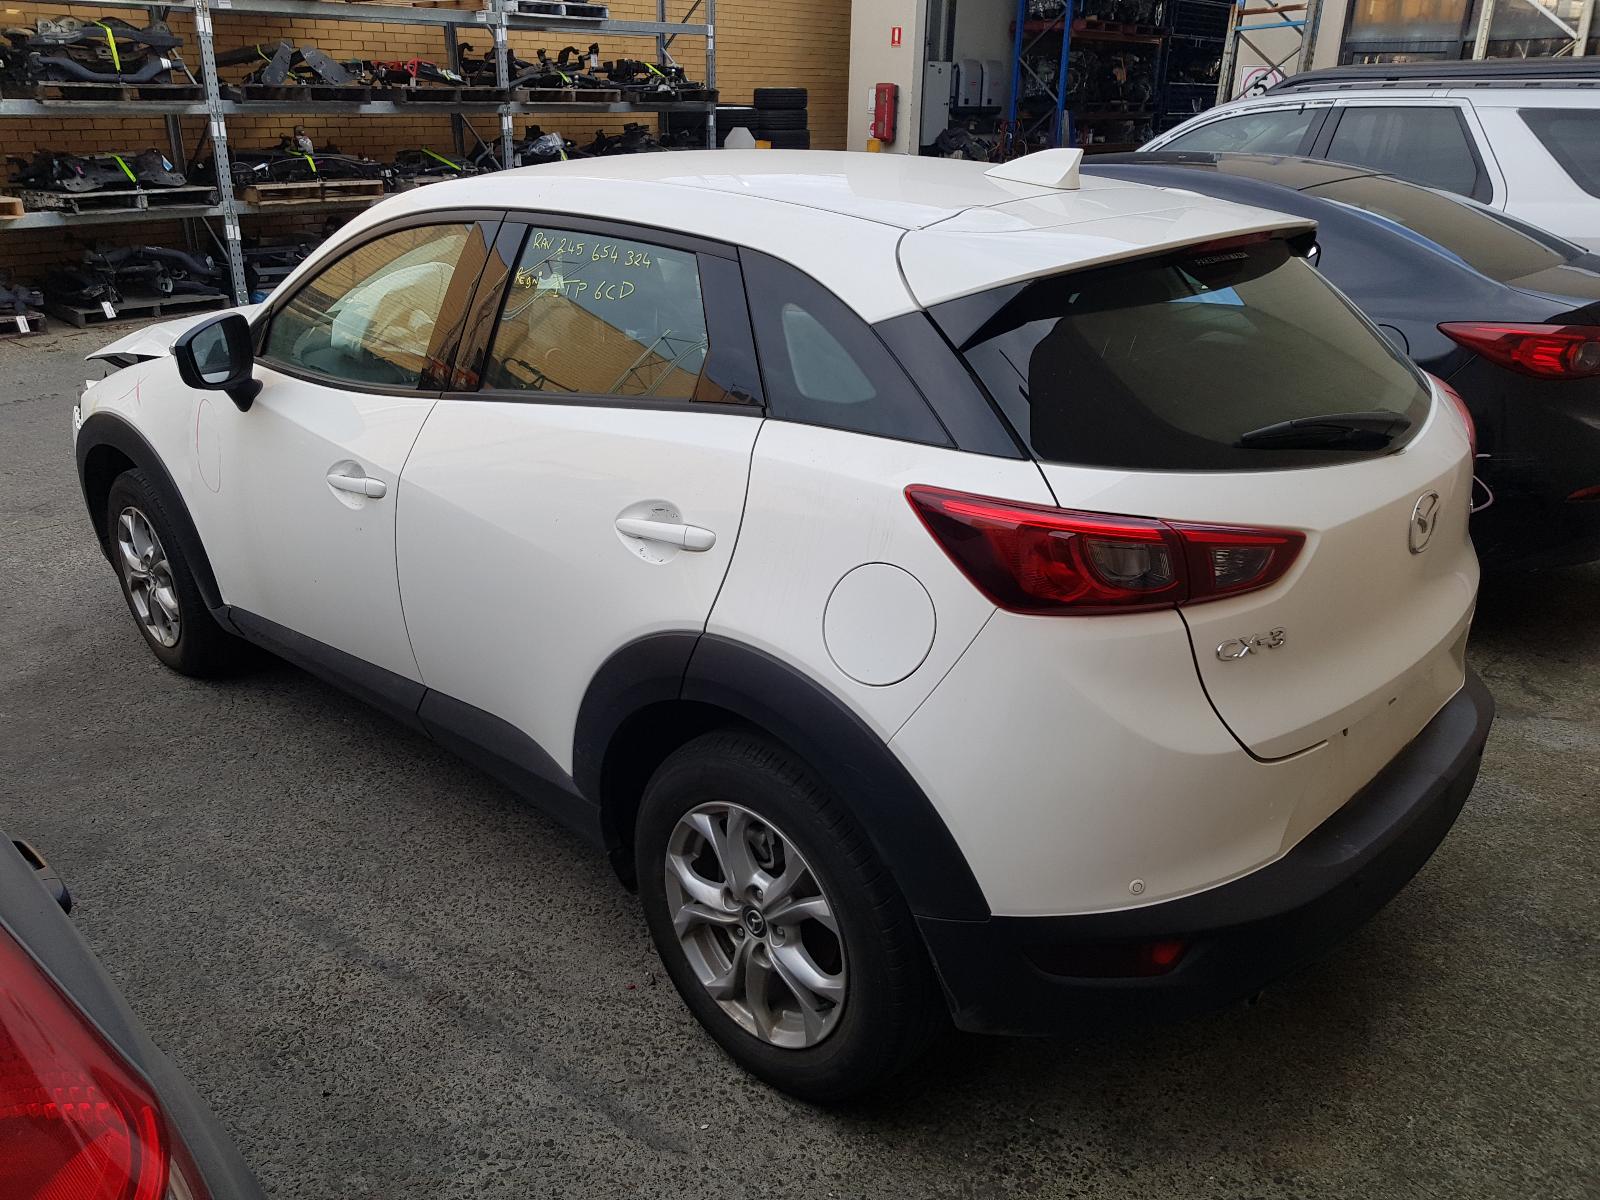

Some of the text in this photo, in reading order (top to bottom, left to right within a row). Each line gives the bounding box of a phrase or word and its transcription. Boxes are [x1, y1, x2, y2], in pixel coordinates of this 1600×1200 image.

[532, 232, 651, 268] RAV 245 654 324
[594, 281, 635, 300] 6CD
[1216, 626, 1287, 662] CX-3
